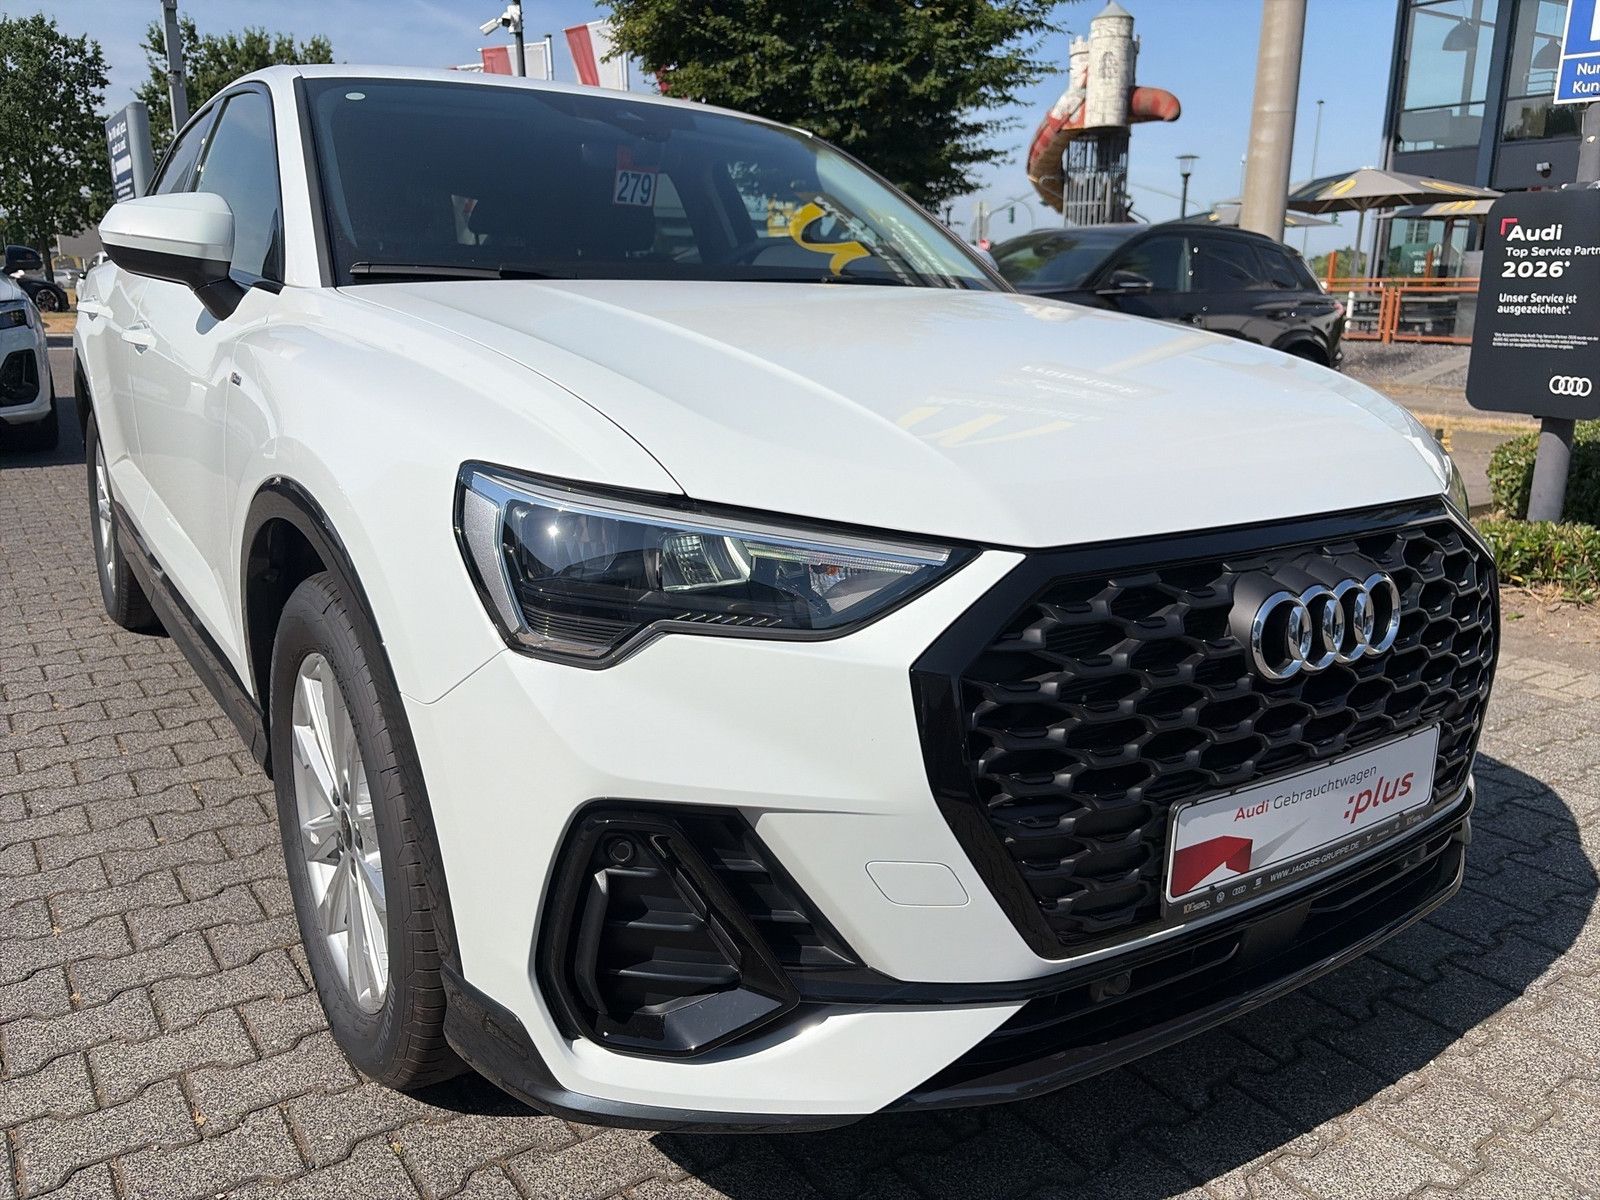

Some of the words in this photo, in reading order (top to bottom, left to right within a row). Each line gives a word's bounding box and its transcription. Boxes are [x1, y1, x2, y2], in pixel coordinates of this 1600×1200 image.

[1576, 62, 1600, 76] Nur
[1572, 81, 1600, 94] Kun
[617, 171, 651, 205] 279
[1506, 224, 1562, 241] Audi
[1506, 247, 1528, 258] Top
[1530, 246, 1572, 256] Service
[1498, 293, 1529, 303] Unser
[1530, 292, 1564, 304] Service
[1565, 293, 1577, 304] ist
[1233, 799, 1269, 822] Audi
[1273, 765, 1377, 810] Gebrauchtwagen
[1343, 771, 1414, 825] :plus
[1270, 840, 1360, 882] WWW.JACOBS-GRUPPE.DE
